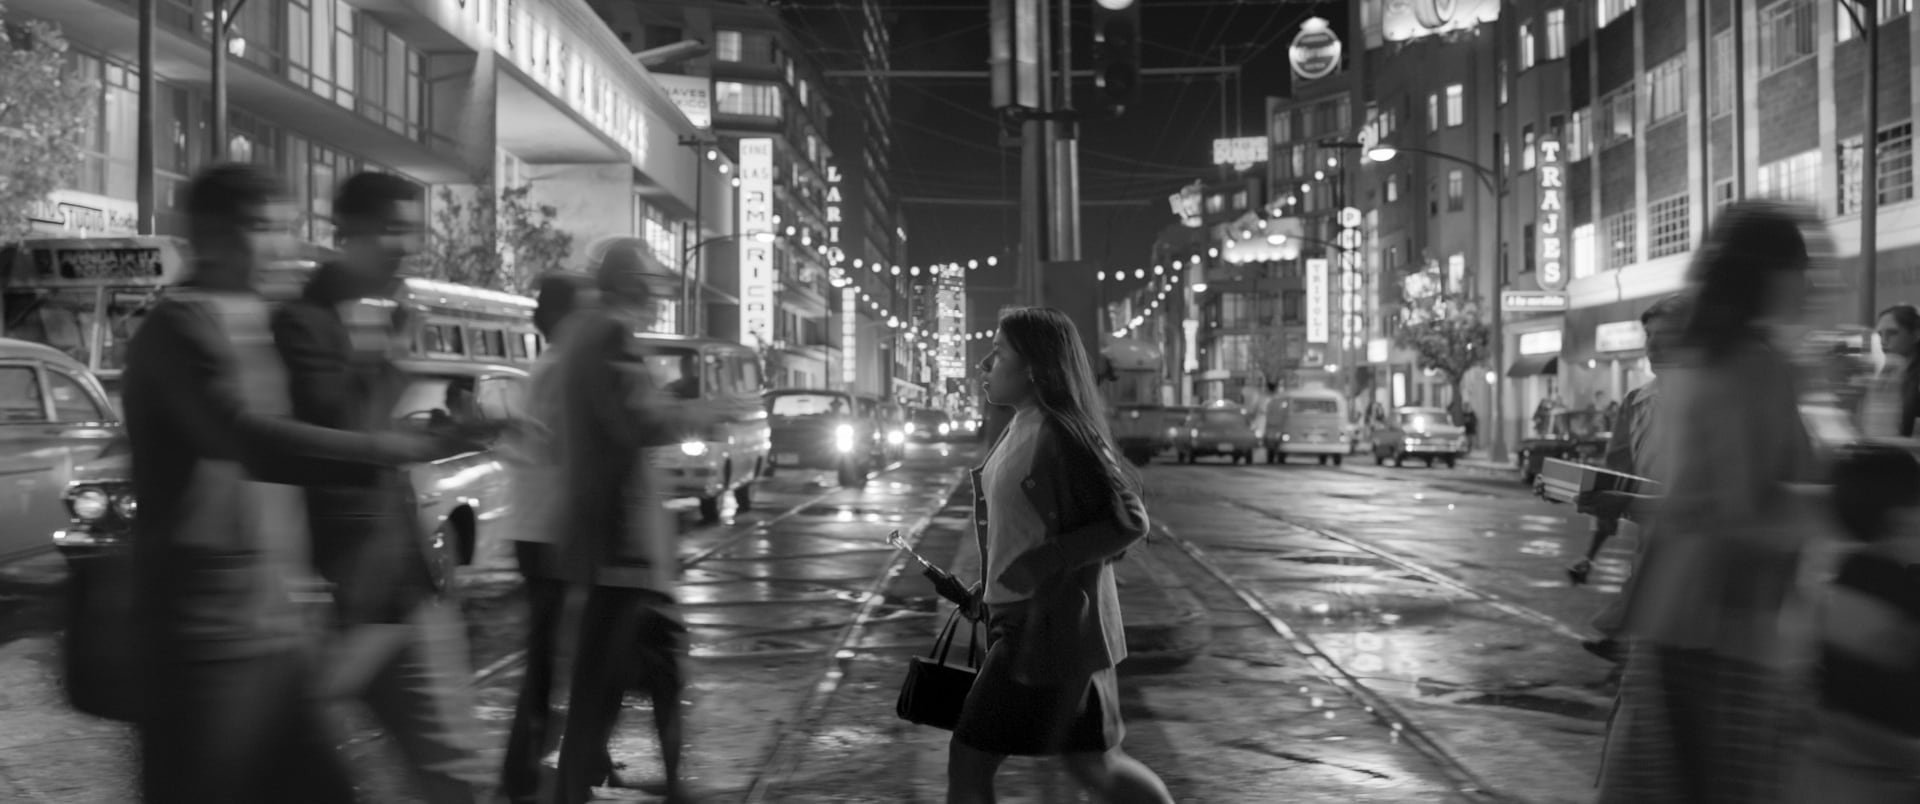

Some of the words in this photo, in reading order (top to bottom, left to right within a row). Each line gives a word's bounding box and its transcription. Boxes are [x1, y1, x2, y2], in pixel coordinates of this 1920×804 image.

[741, 144, 769, 156] CINE
[742, 167, 769, 180] LAS
[1541, 141, 1562, 283] TRAJES
[746, 190, 766, 335] AMERICAS
